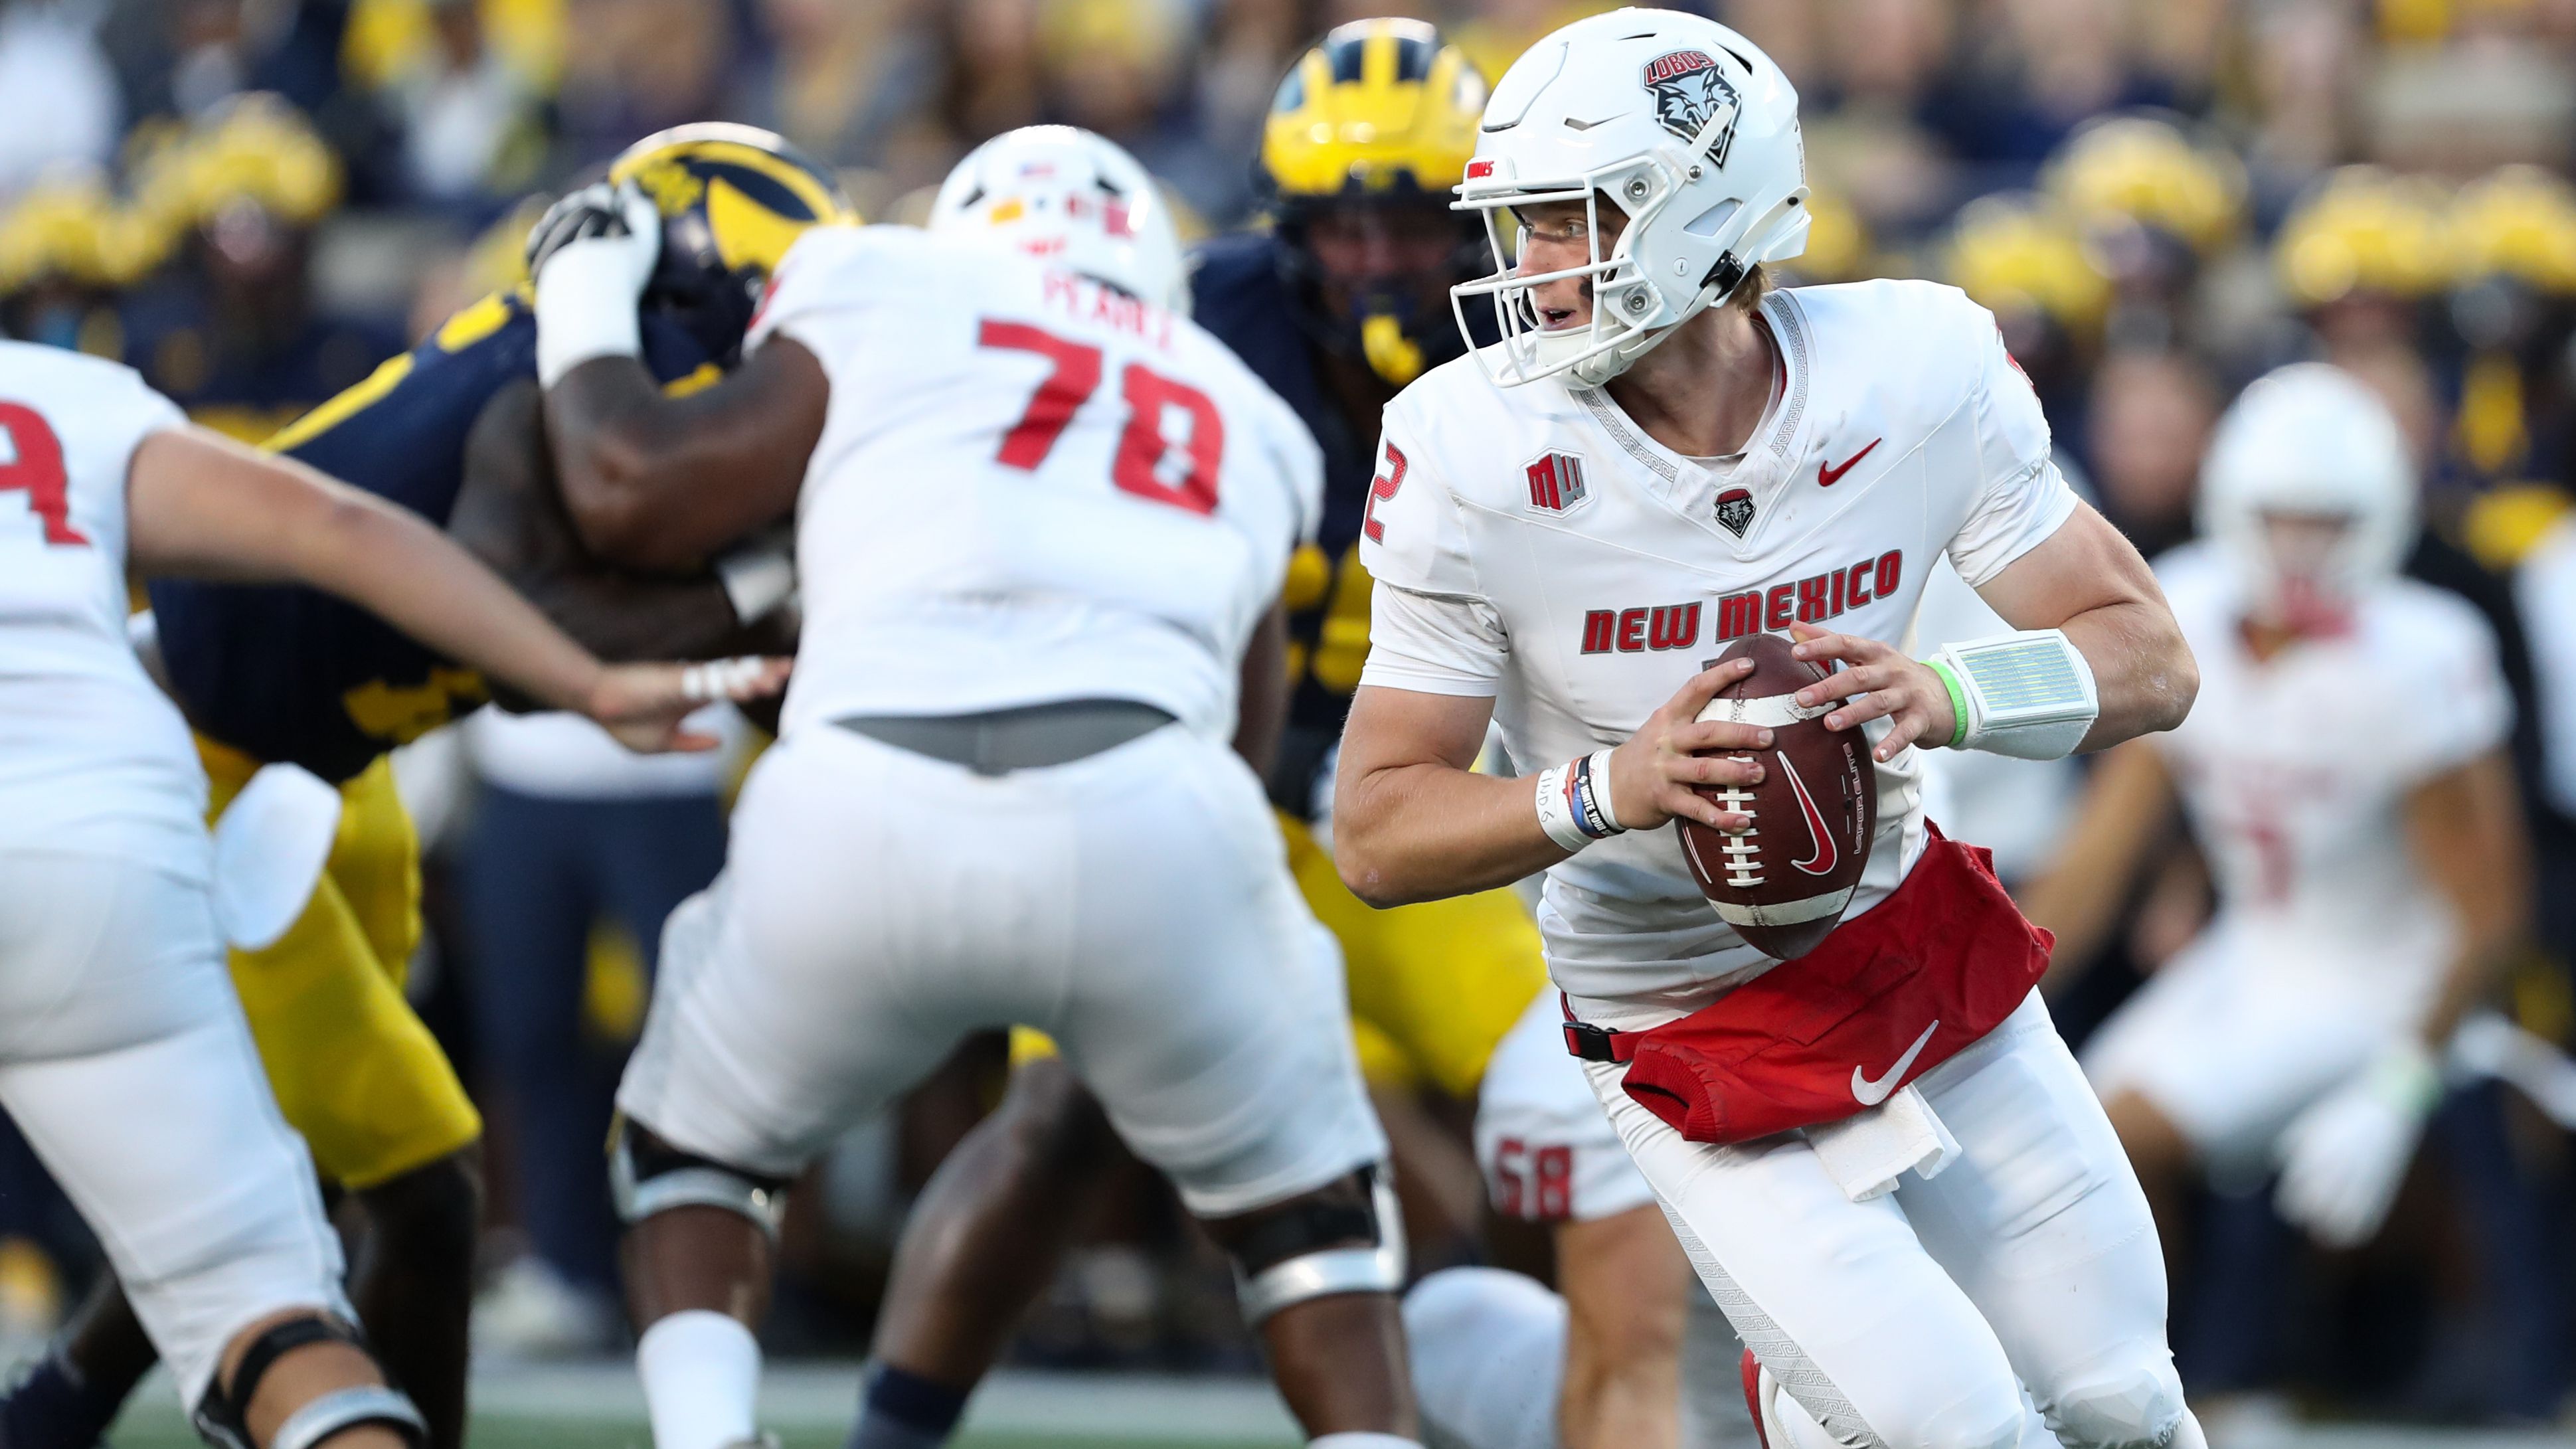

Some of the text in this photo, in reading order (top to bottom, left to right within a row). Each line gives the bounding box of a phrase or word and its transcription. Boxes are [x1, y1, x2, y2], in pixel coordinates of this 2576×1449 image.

[1645, 51, 1717, 86] LOBOS
[976, 317, 1225, 520] 78
[1364, 438, 1408, 546] 2
[1581, 549, 1903, 655] NEW MEXICO
[1589, 810, 1607, 831] YOUR
